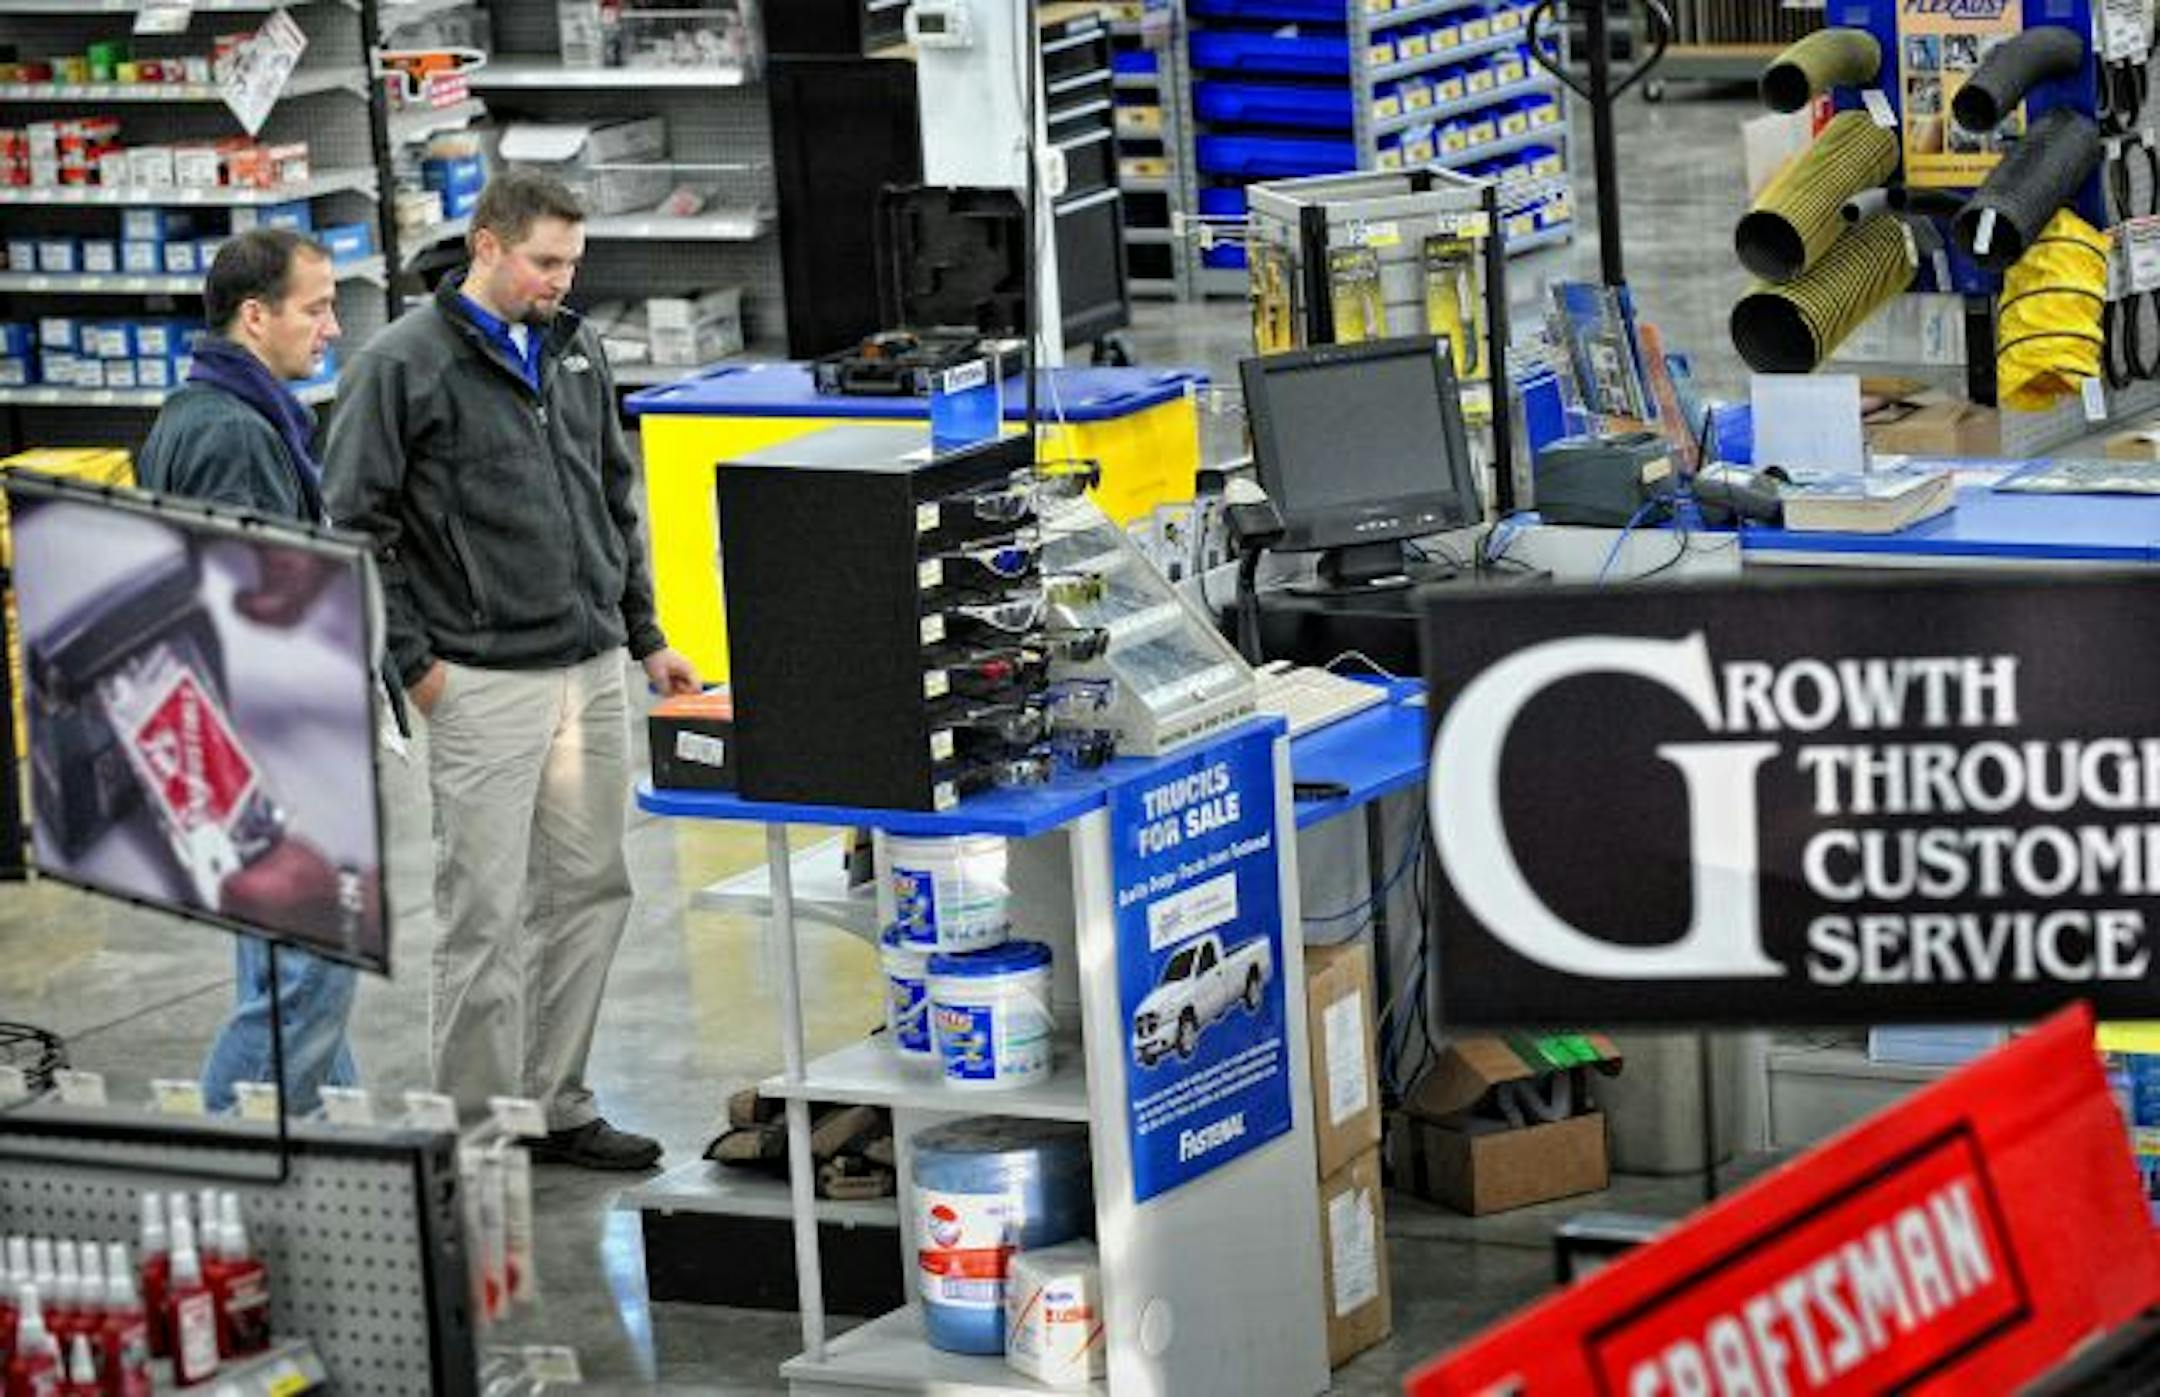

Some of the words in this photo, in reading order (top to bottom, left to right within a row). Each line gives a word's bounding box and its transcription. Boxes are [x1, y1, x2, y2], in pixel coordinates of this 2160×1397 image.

[1138, 816, 1181, 859] FOR
[1184, 791, 1240, 839] SALE
[1142, 761, 1230, 821] TRUCKS
[1803, 823, 2160, 901] CUSTOM
[1806, 906, 2150, 985] SERVICE
